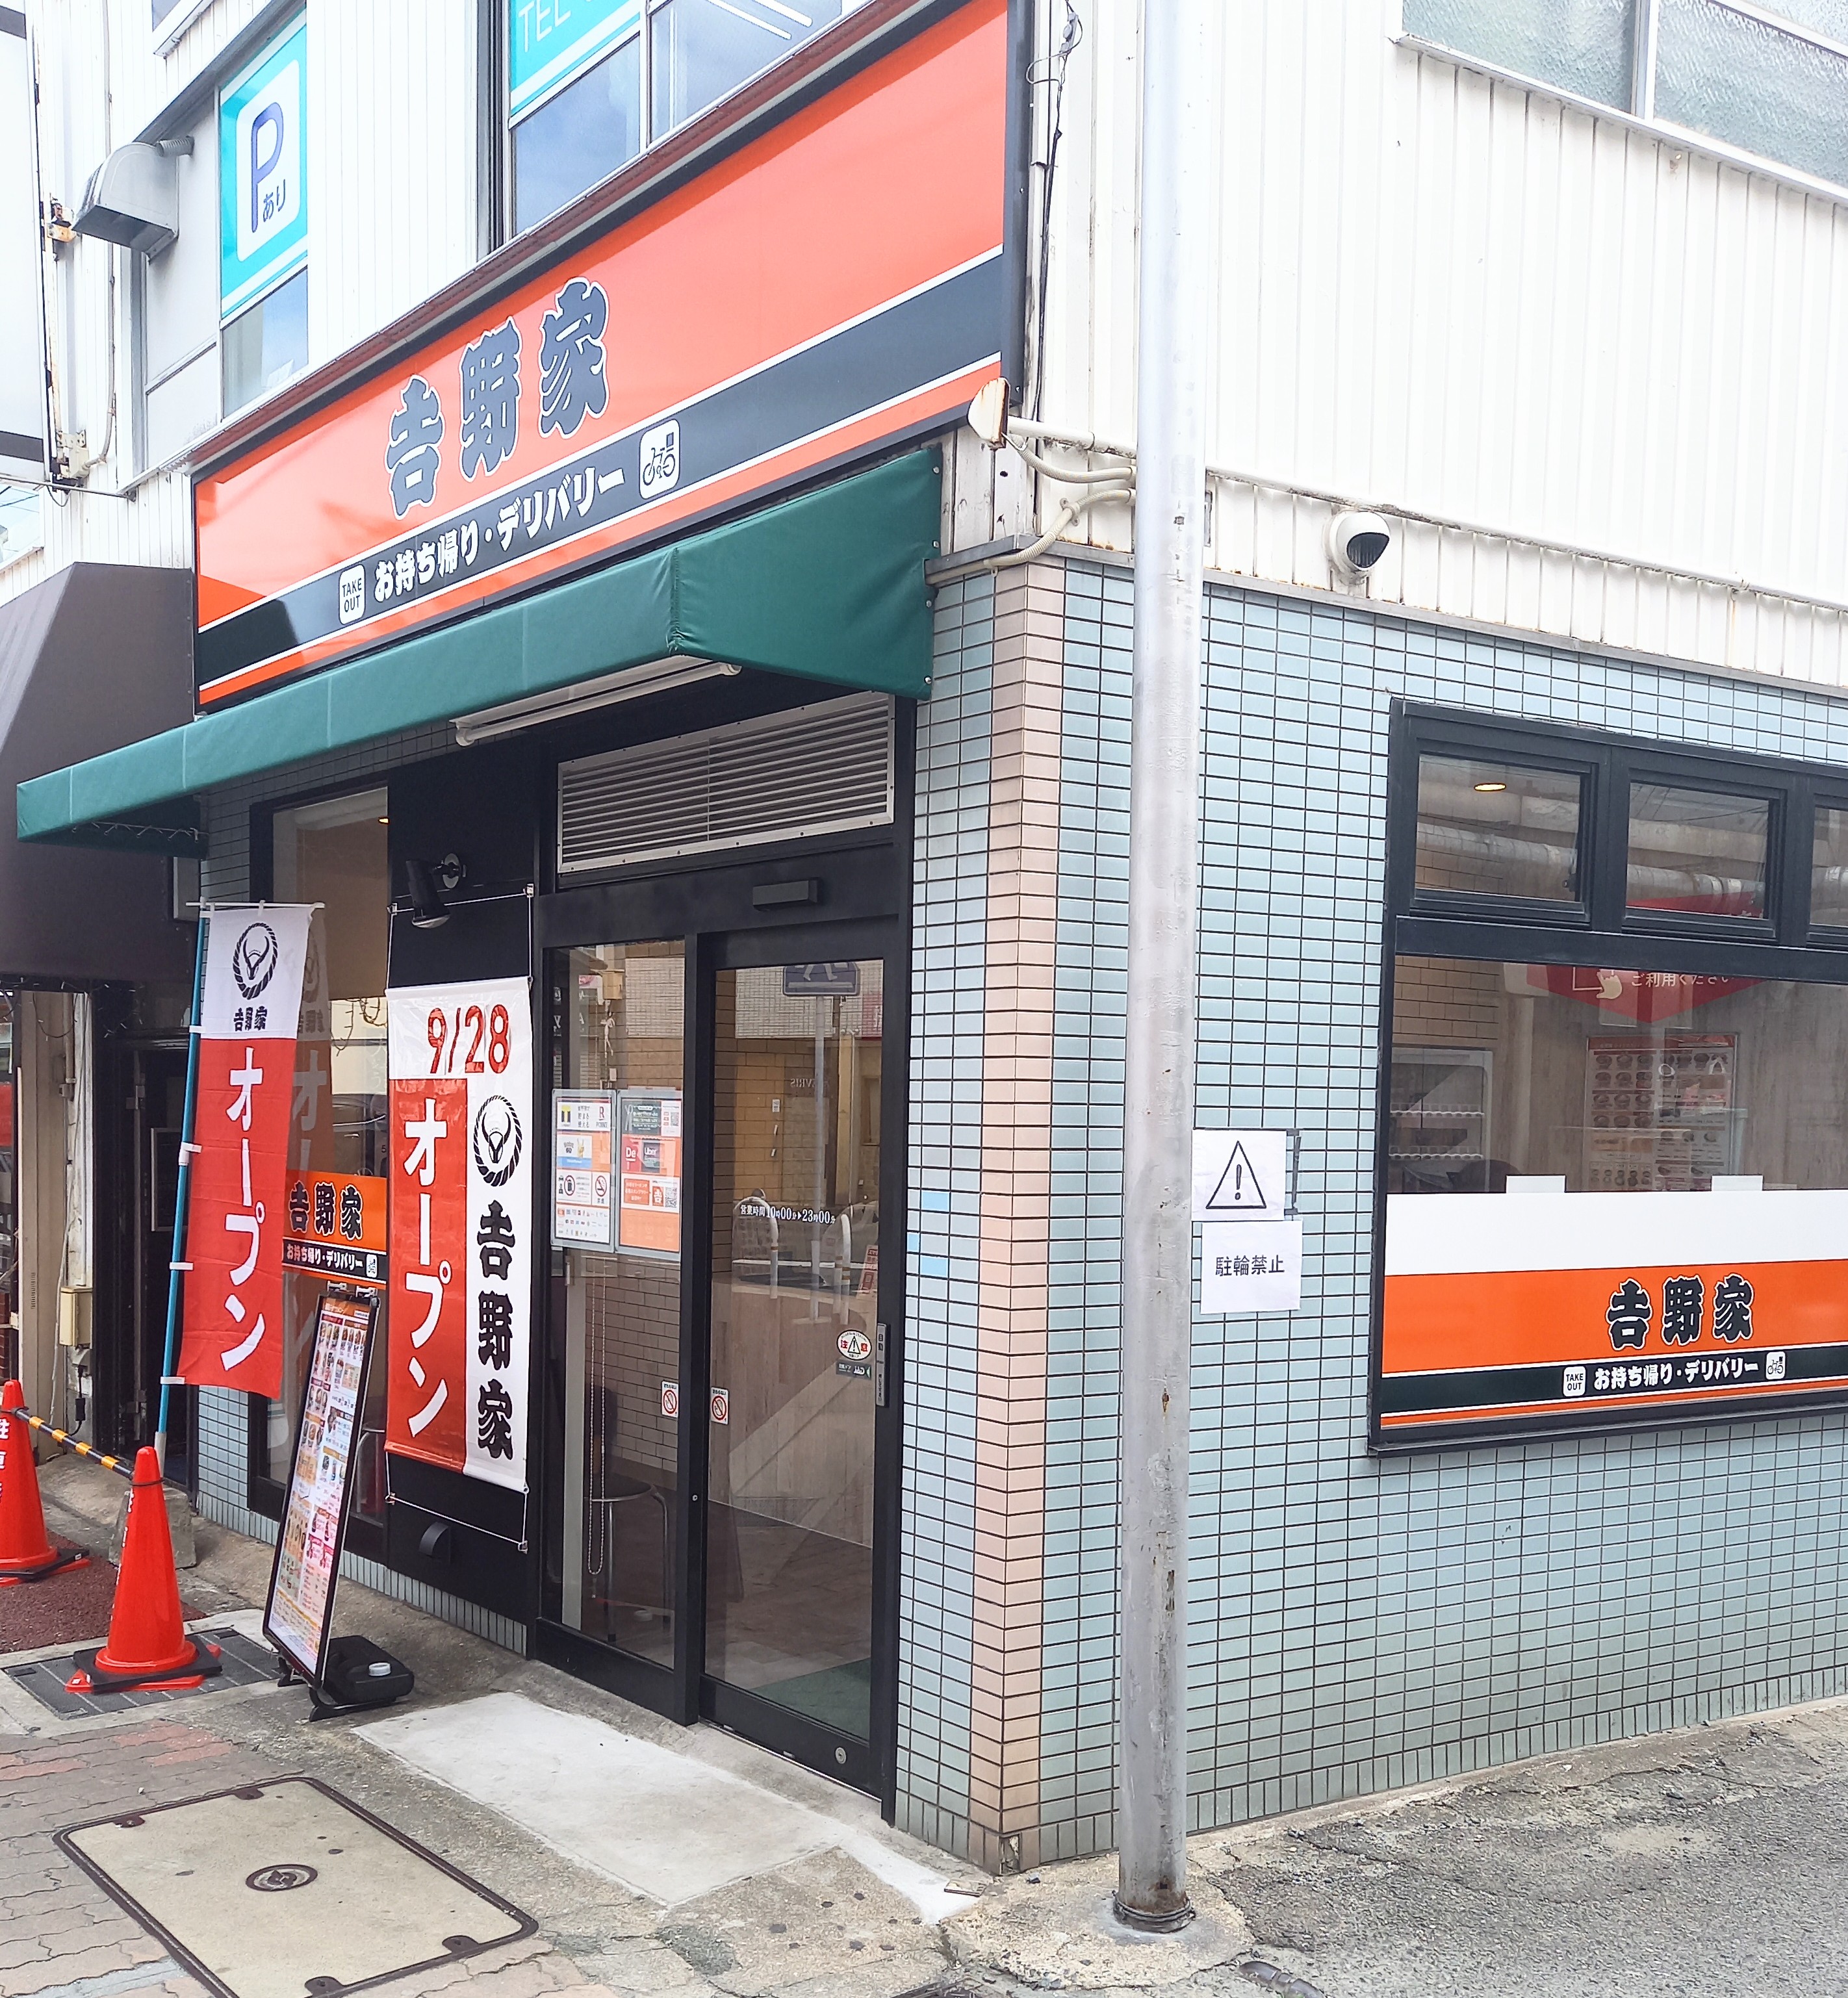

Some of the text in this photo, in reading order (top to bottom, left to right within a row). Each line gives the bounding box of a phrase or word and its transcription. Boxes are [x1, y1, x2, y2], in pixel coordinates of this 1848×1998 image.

[518, 0, 571, 53] TEL
[263, 179, 287, 222] あり
[373, 466, 626, 603] お持ち帰り・デリバリー
[342, 577, 363, 598] TAKE
[343, 595, 361, 613] OUT
[426, 1003, 512, 1075] 9/28
[644, 1146, 657, 1156] Uber
[220, 1045, 266, 1371] オープン
[286, 1242, 364, 1272] お持ち帰り・デリバリー
[403, 1097, 451, 1439] オープン
[1215, 1254, 1285, 1277] 駐輪禁止
[1565, 1373, 1584, 1382] TAKE
[1567, 1382, 1582, 1391] OUT
[1593, 1357, 1759, 1390] お持ち帰り・デリバリー
